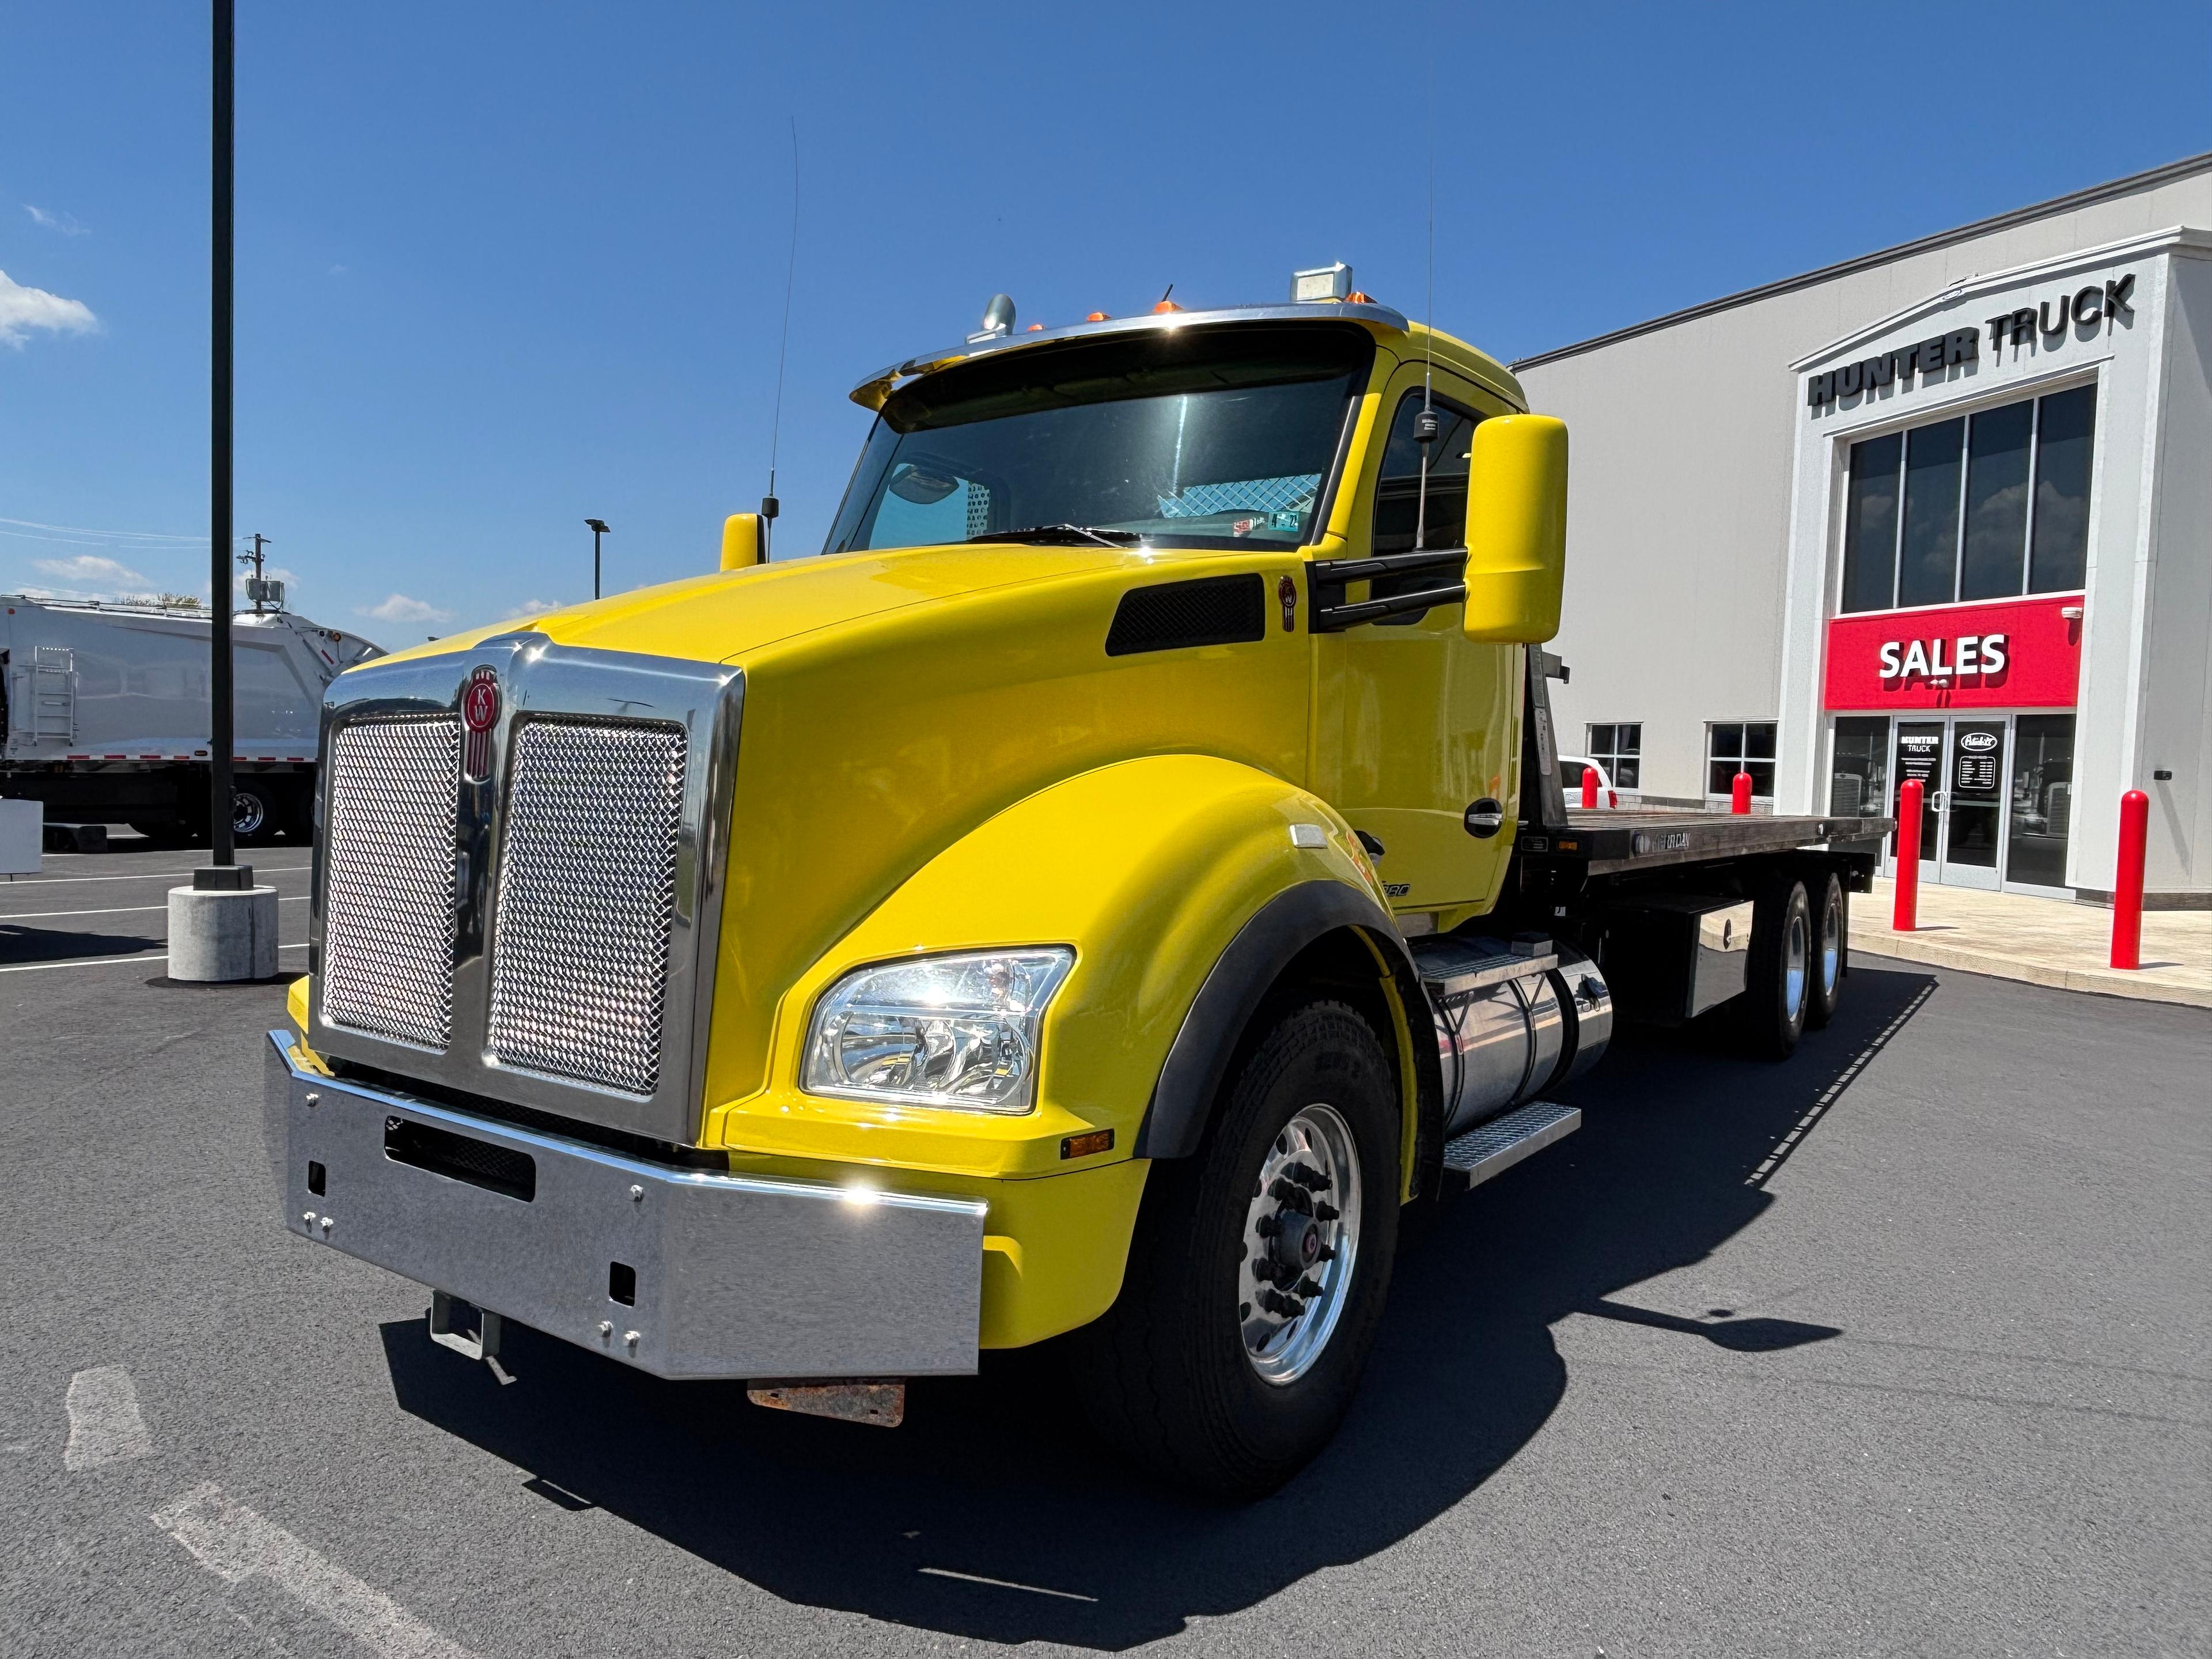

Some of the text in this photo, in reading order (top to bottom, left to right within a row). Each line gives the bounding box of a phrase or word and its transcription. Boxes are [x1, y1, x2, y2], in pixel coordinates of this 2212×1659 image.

[1808, 274, 2136, 407] HUNTER TRUCK
[1879, 634, 2008, 678] SALES
